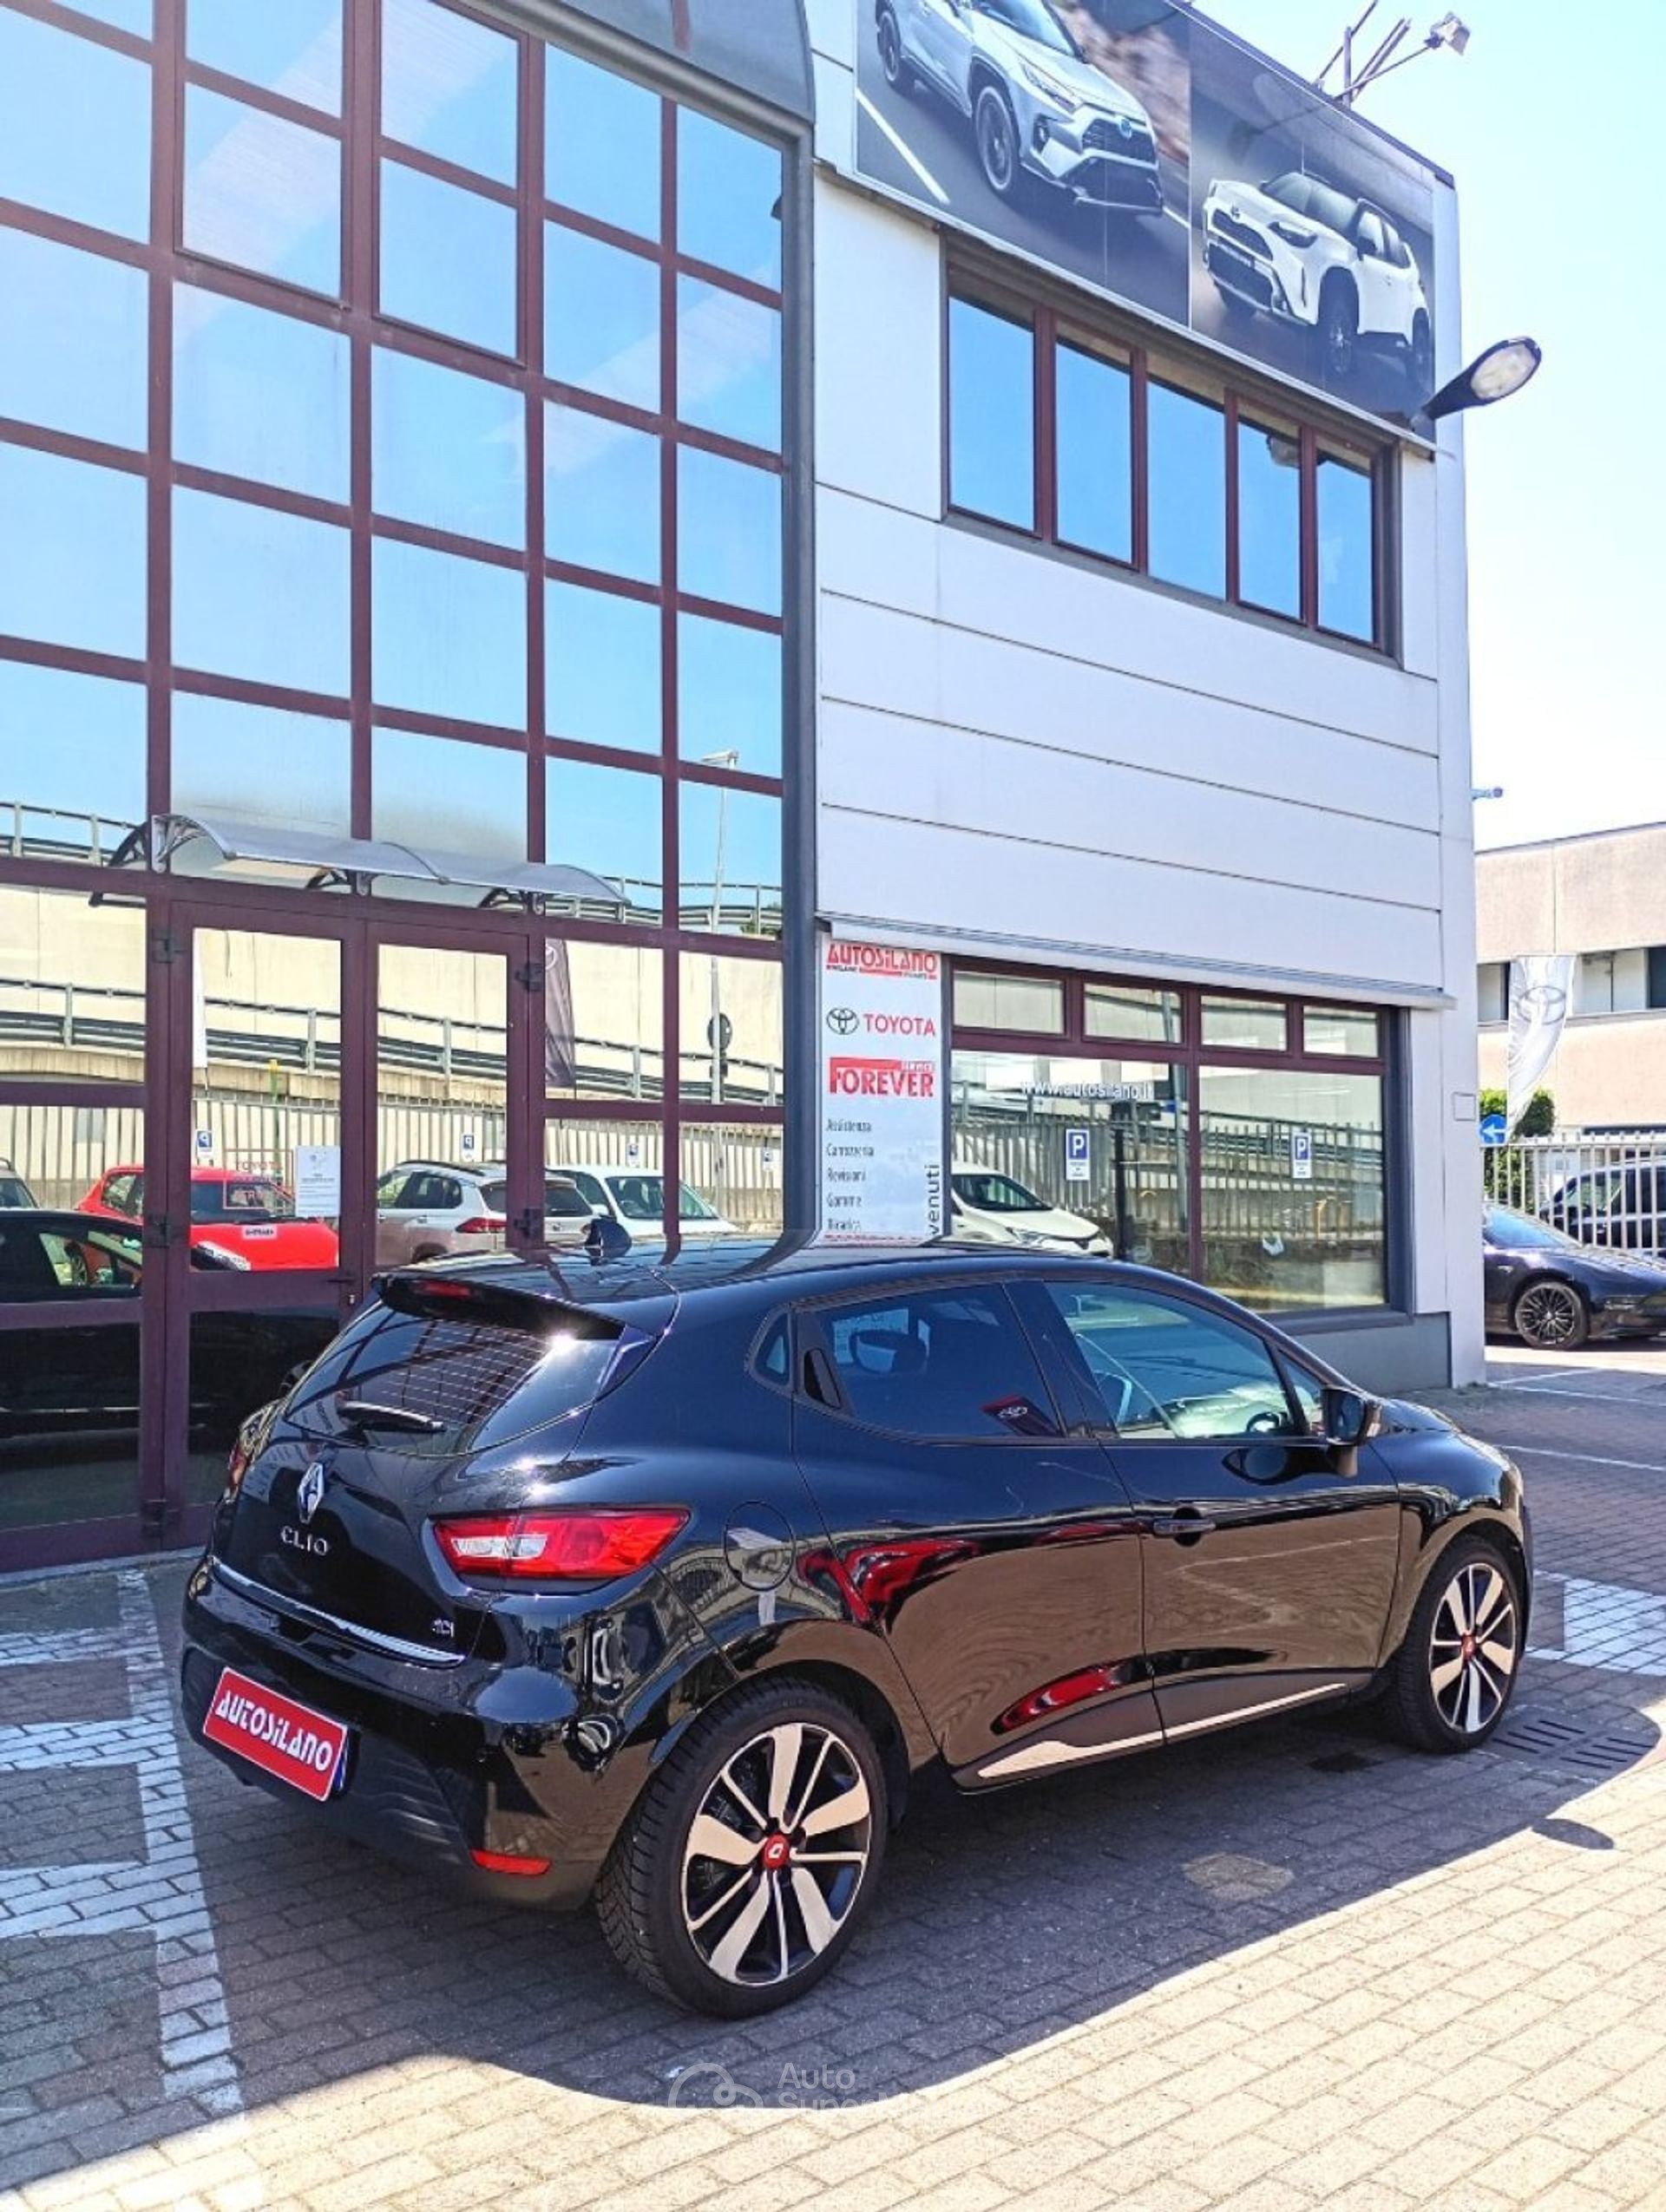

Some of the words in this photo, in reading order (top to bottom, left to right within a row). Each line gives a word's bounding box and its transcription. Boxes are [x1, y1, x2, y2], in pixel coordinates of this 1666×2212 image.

[863, 1013, 935, 1037] TOYOTA
[829, 1057, 935, 1097] FOREVER
[1072, 1135, 1085, 1156] P
[1296, 1137, 1307, 1160] P
[280, 1526, 328, 1556] CLIO
